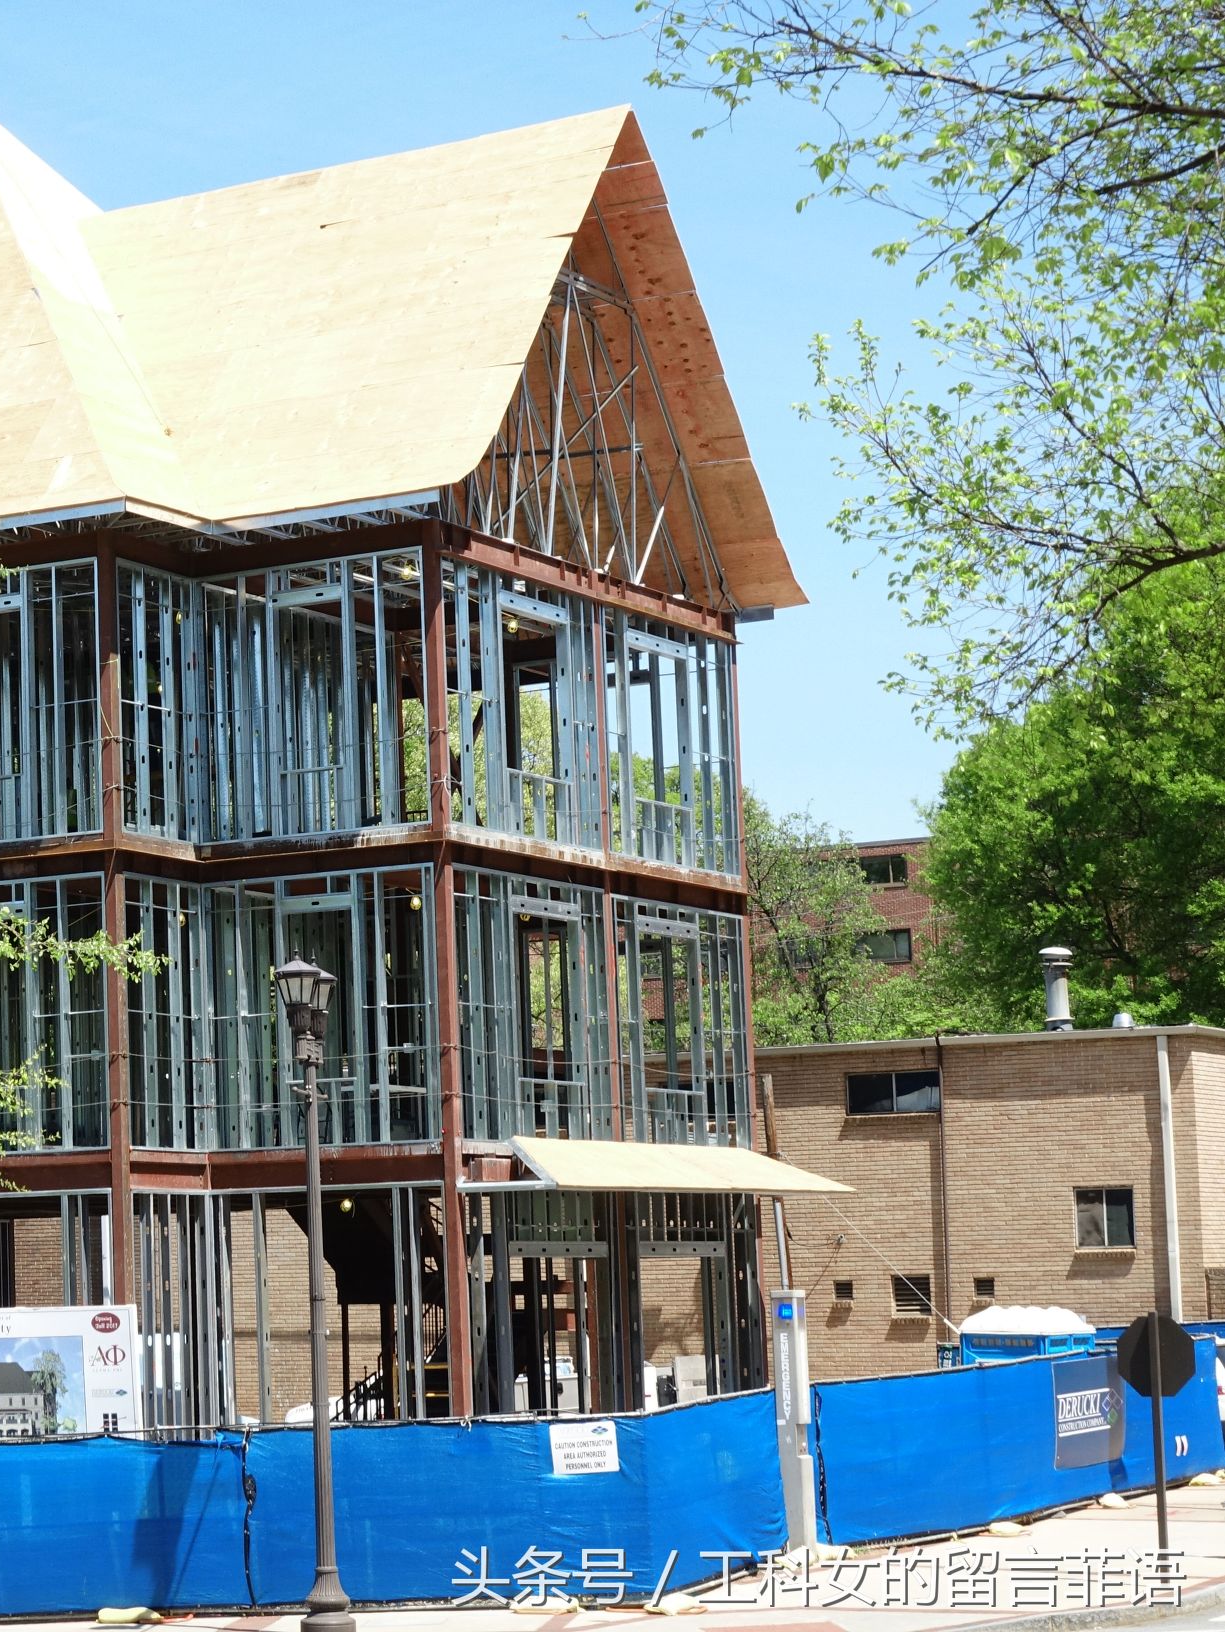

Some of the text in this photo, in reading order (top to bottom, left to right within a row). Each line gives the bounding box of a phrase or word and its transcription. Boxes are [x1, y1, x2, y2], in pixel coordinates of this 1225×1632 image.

[780, 1333, 791, 1420] EMERGENCY
[1058, 1393, 1101, 1419] DERUCKI
[576, 1439, 613, 1448] CONSTRUCTION
[563, 1450, 607, 1460] AREA AUTHORIZED
[565, 1460, 606, 1470] PERSONNEL ONLY
